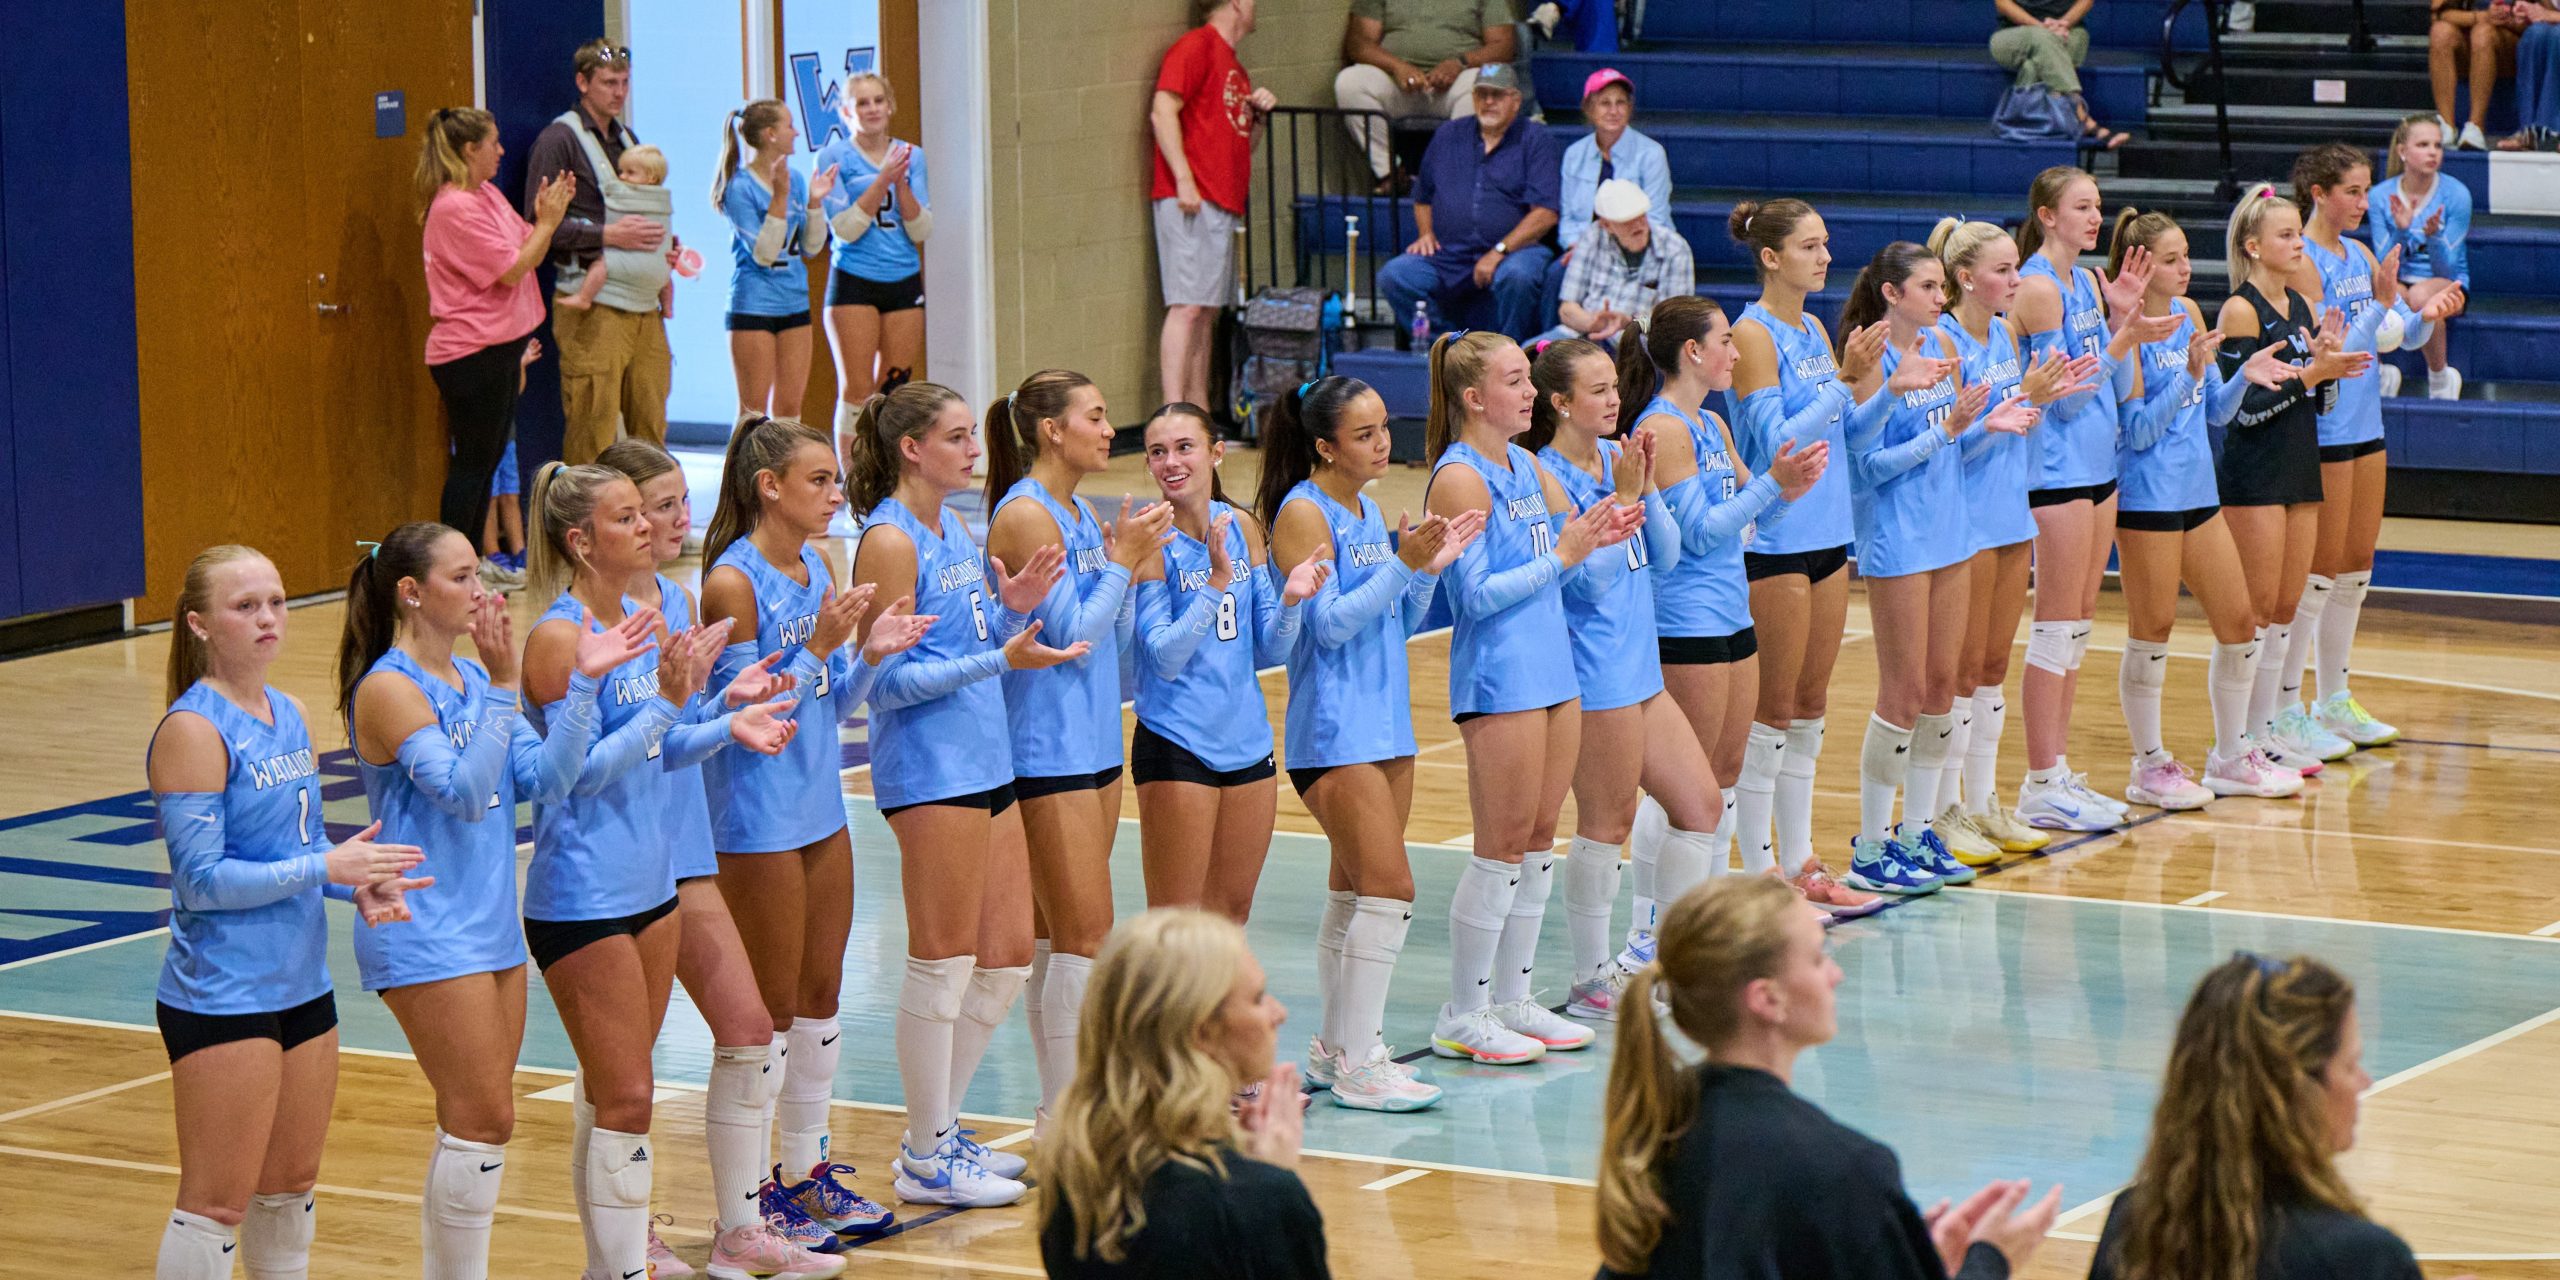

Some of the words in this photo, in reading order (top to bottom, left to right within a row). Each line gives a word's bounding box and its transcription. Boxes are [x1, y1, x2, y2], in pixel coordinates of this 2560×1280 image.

[1530, 520, 1552, 560] 10
[968, 589, 988, 642] 6
[1215, 591, 1239, 642] 8
[298, 786, 311, 847] 1
